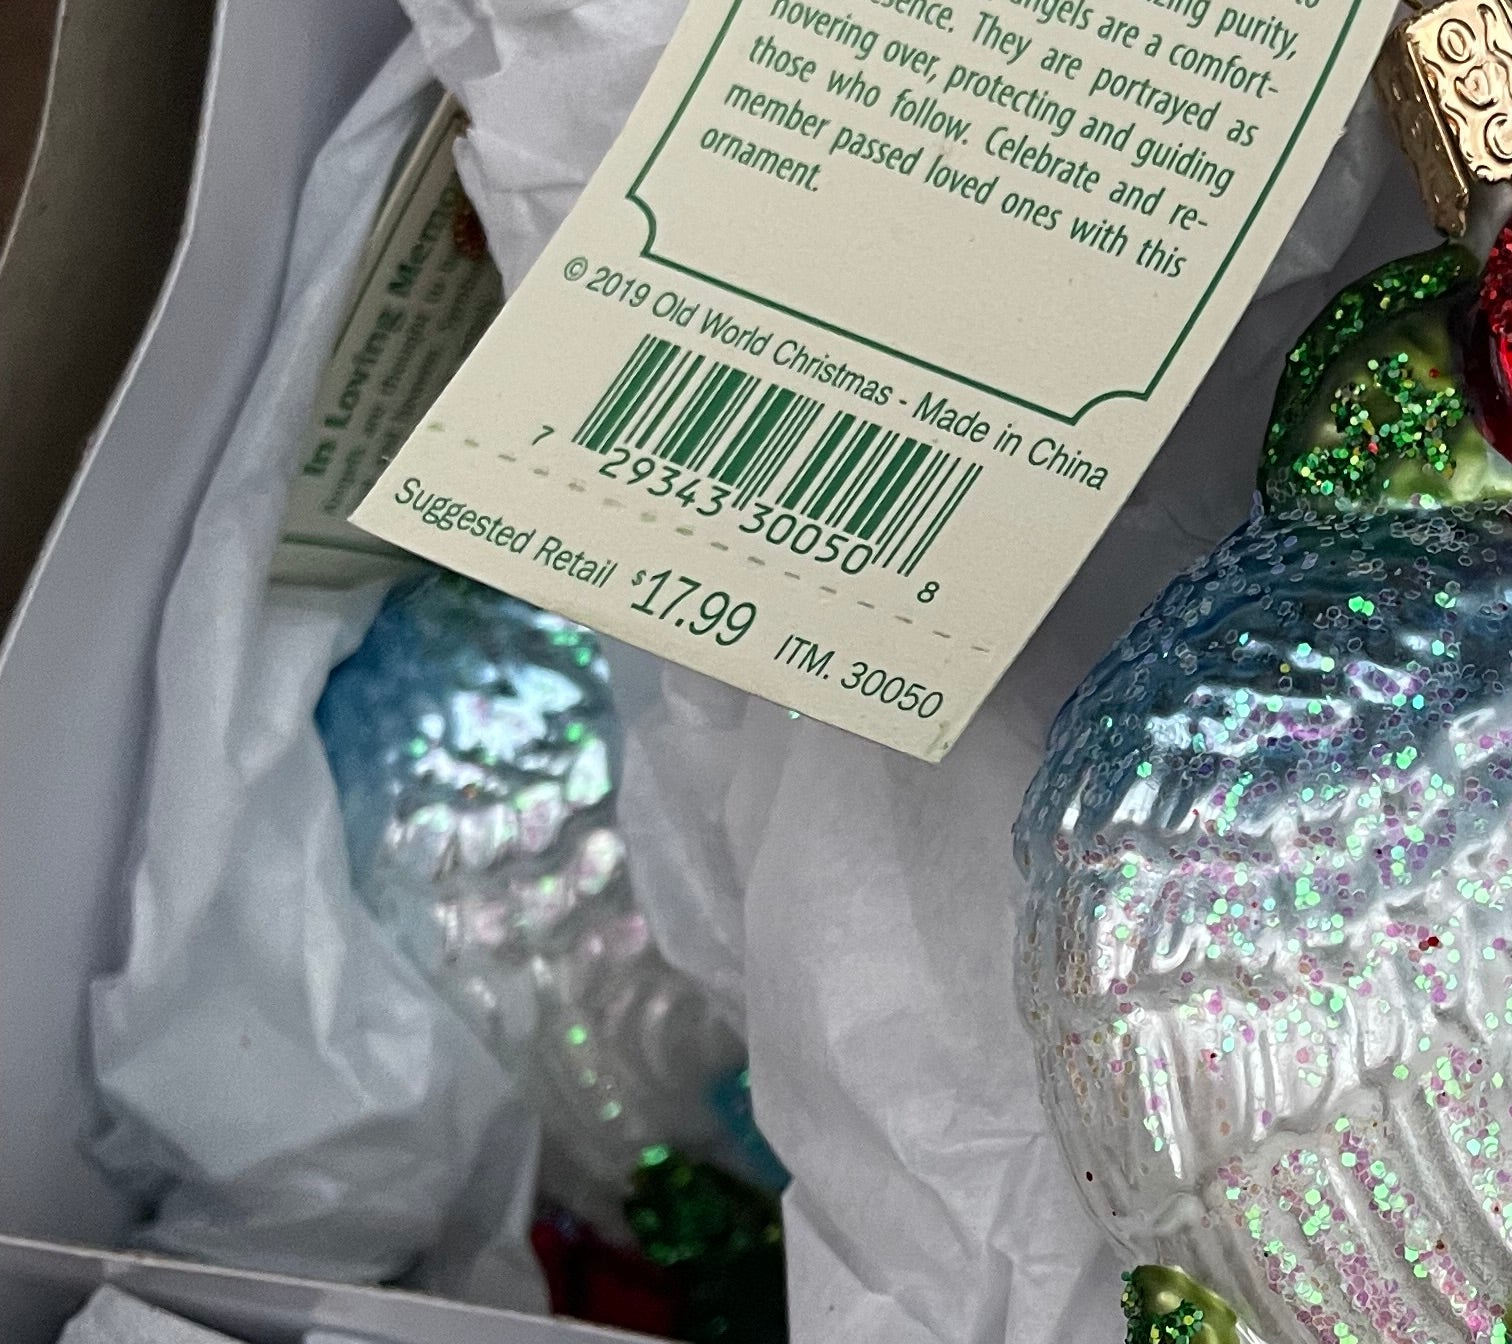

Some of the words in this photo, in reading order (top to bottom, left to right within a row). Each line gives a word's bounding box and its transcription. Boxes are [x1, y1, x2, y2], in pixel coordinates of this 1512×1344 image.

[971, 10, 1033, 66] They
[1039, 47, 1083, 81] are
[1087, 67, 1223, 132] portrayed
[1225, 118, 1260, 148] as
[1096, 15, 1140, 49] are
[1143, 33, 1163, 59] a
[1168, 42, 1279, 99] comfort-
[1213, 6, 1299, 61] purity,
[699, 127, 822, 193] ornament.
[723, 83, 833, 140] member
[827, 125, 925, 177] passed
[923, 153, 1001, 206] loved
[1000, 191, 1063, 231] ones
[1069, 216, 1129, 258] with
[1135, 238, 1188, 279] this
[748, 34, 817, 84] those
[826, 69, 882, 108] who
[889, 88, 973, 146] follow.
[984, 125, 1101, 194] Celebrate
[1108, 180, 1167, 217] and
[1167, 203, 1209, 231] re-
[882, 39, 942, 85] over,
[942, 63, 1078, 138] protecting
[1078, 114, 1137, 153] and
[1130, 137, 1236, 199] guiding
[563, 255, 589, 282] ©
[584, 265, 652, 308] 2019
[651, 290, 701, 328] Old
[698, 307, 775, 357] World
[772, 338, 894, 406] Christmas
[911, 391, 991, 443] Made
[992, 422, 1023, 457] in
[1027, 436, 1109, 491] China
[393, 476, 537, 555] Suggested
[532, 535, 619, 589] Retail
[629, 568, 758, 647] $17.99
[773, 633, 836, 681] ITM.
[840, 661, 944, 719] 30050
[531, 424, 556, 447] 7
[597, 446, 733, 518] 29343
[737, 501, 874, 576] 30050
[916, 580, 941, 604] 8
